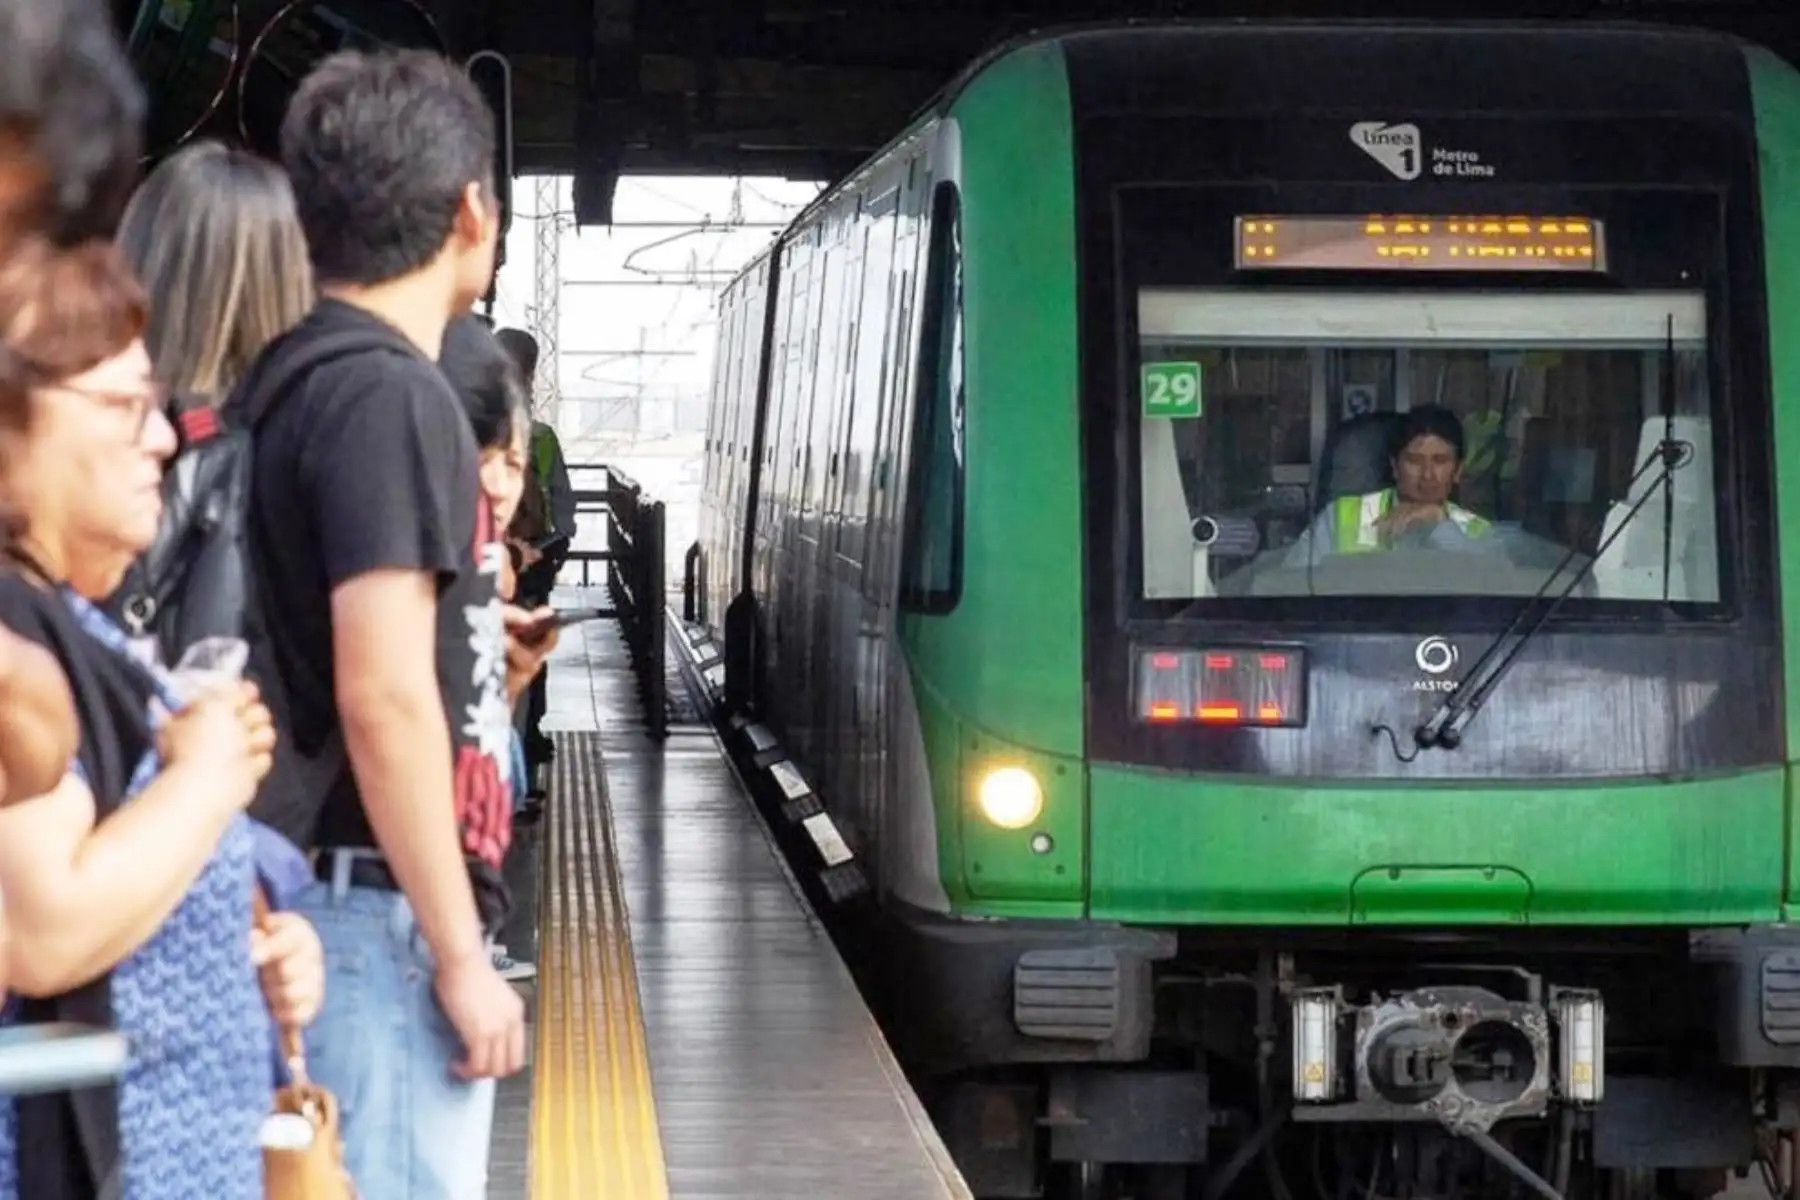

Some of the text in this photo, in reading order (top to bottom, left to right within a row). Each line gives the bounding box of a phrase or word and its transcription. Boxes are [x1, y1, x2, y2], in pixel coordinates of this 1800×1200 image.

[1398, 148, 1413, 172] 1
[1432, 148, 1479, 162] Metro
[1432, 162, 1495, 176] de Lima
[1147, 373, 1196, 406] 29
